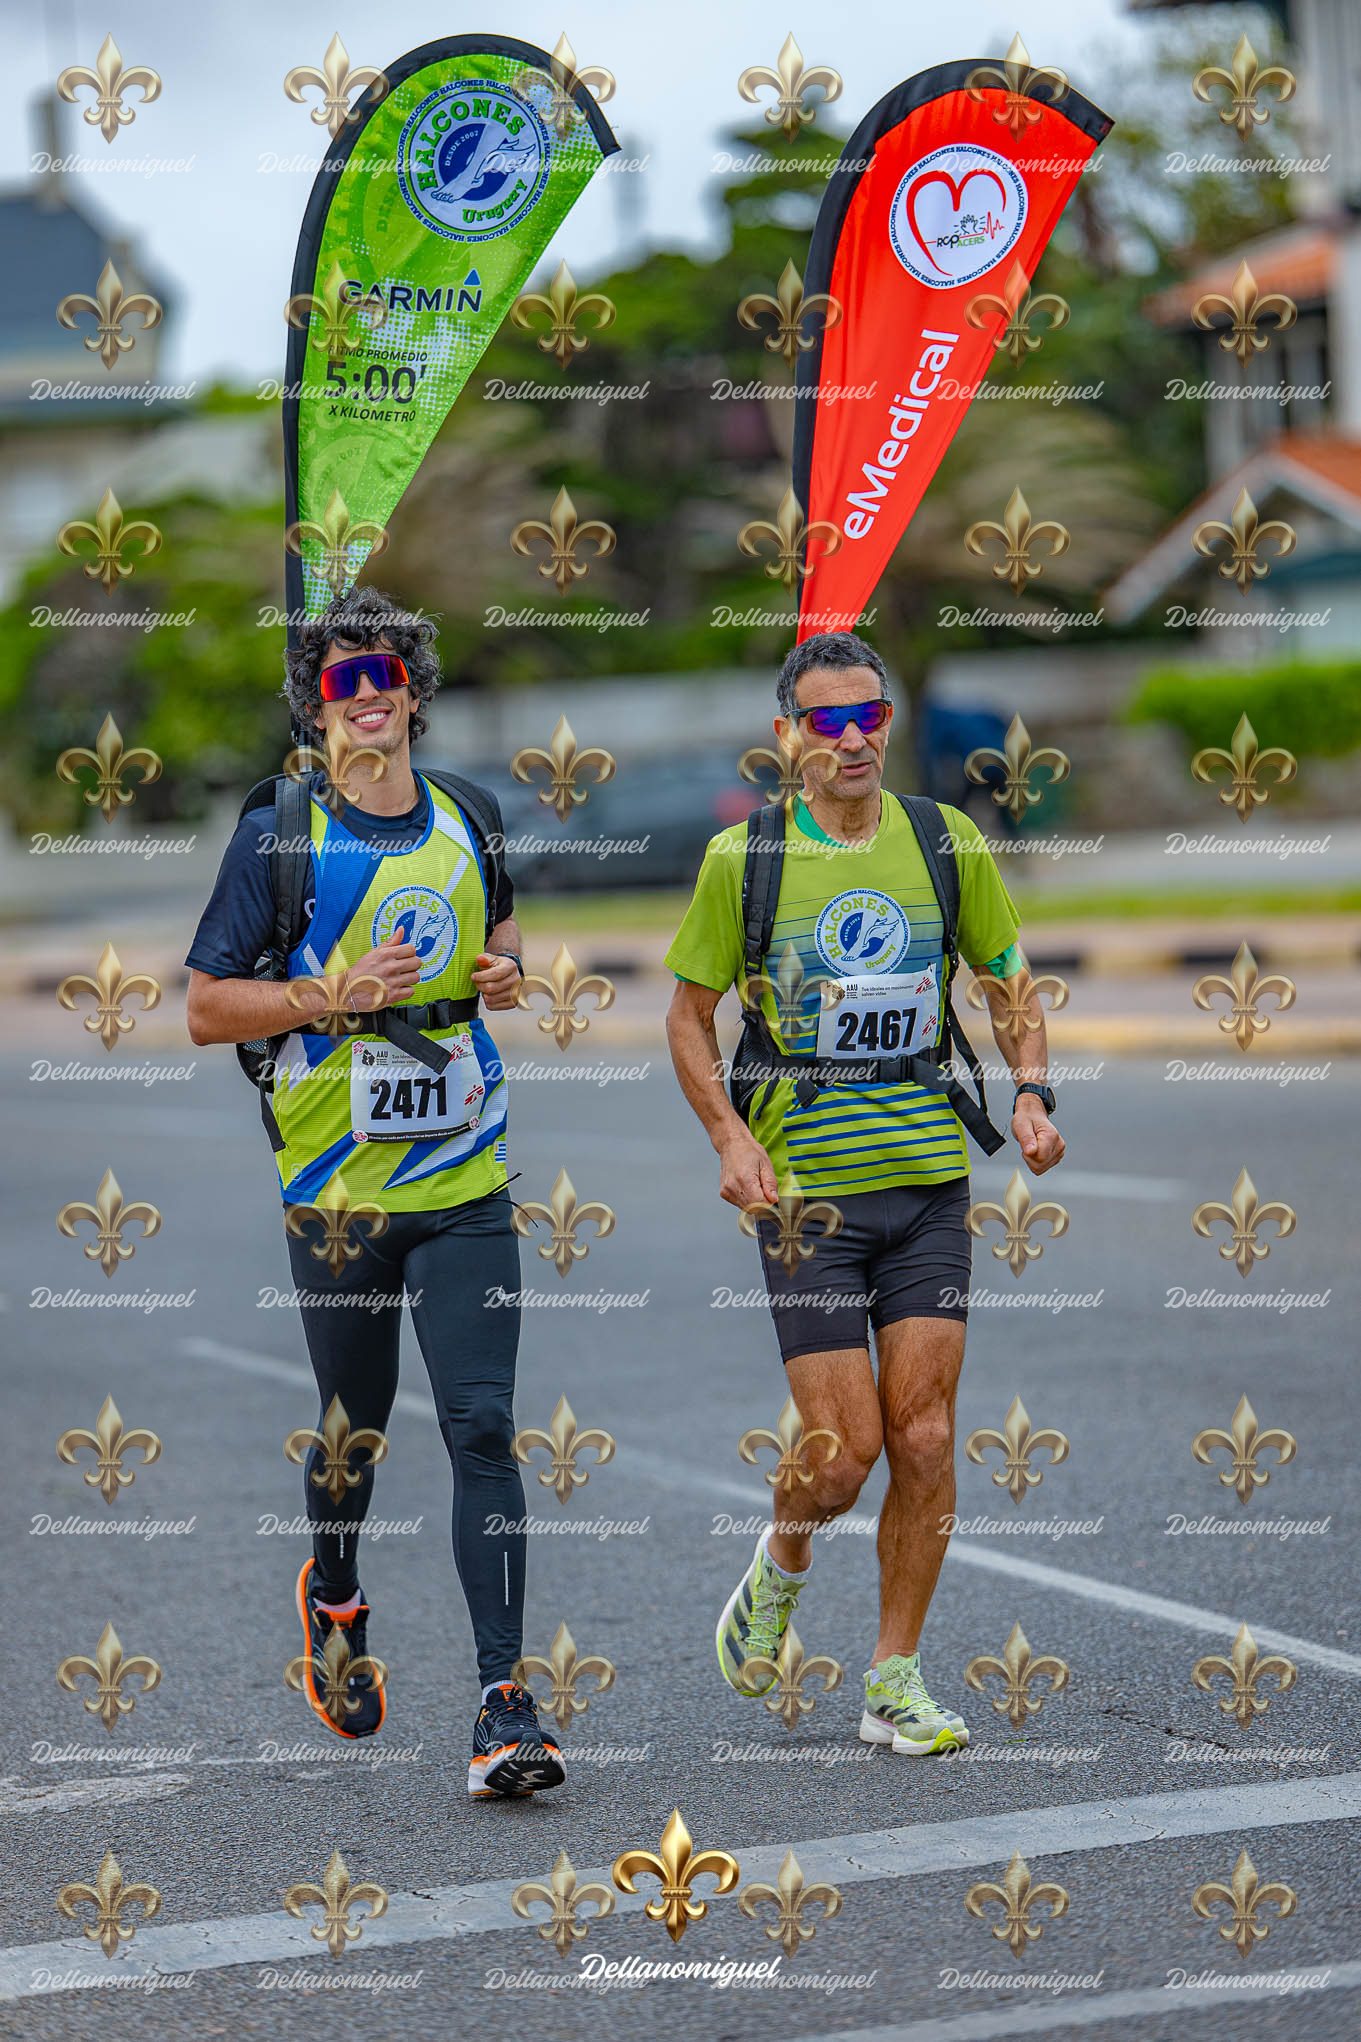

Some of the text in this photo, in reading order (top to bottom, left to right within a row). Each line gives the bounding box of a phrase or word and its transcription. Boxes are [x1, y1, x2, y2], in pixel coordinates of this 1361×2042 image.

[415, 98, 526, 191] HALCONES
[462, 178, 527, 223] Uruguay
[338, 280, 482, 313] GARMIN
[366, 348, 428, 362] PROMEDIO
[325, 360, 428, 404] 5:00'
[328, 404, 417, 422] X KILOMETRO
[843, 328, 960, 540] eMedical
[380, 894, 440, 942] ALCONES
[825, 897, 889, 960] HALCONES
[865, 944, 896, 968] Uruguay
[835, 1007, 917, 1052] 2467
[370, 1076, 448, 1120] 2471
